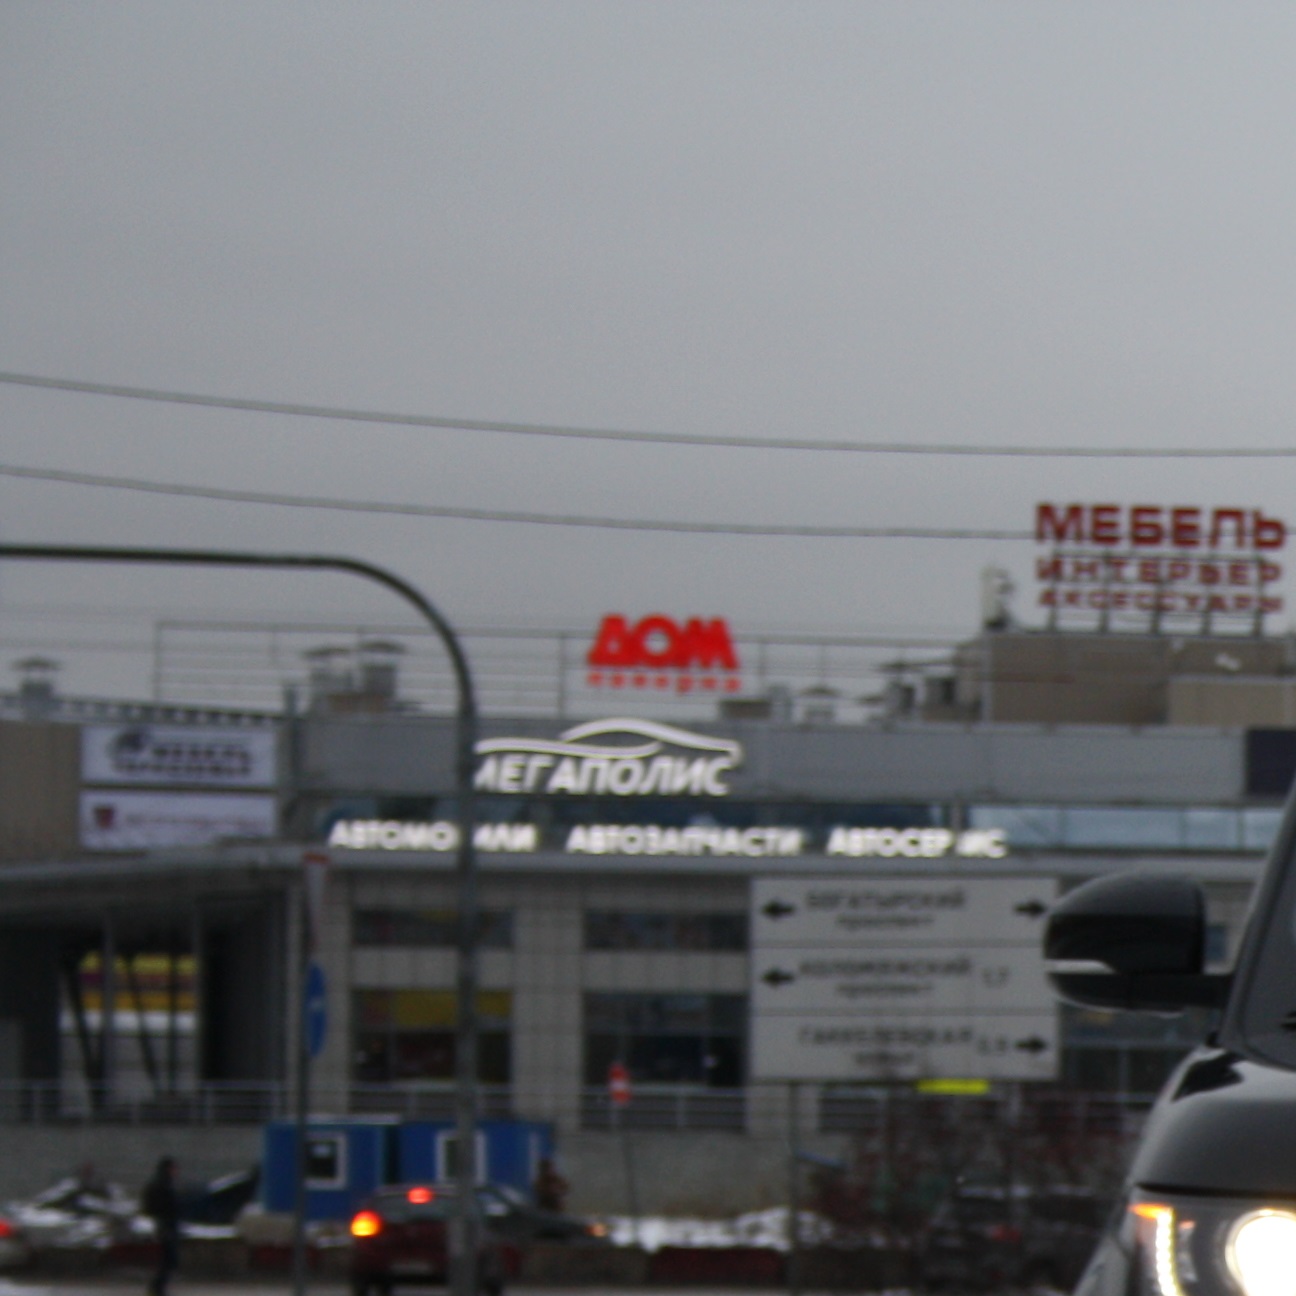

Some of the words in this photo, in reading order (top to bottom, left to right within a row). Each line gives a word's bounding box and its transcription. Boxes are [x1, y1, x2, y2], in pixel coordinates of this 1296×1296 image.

[1034, 502, 1286, 549] МЕБЕЛЬ
[1035, 556, 1283, 585] ИНТЕРЬЕР
[587, 614, 740, 671] ДОМ
[328, 819, 537, 852] АВТОМОИЛИ
[565, 824, 803, 857] АВТОЗАПЧАСТИ
